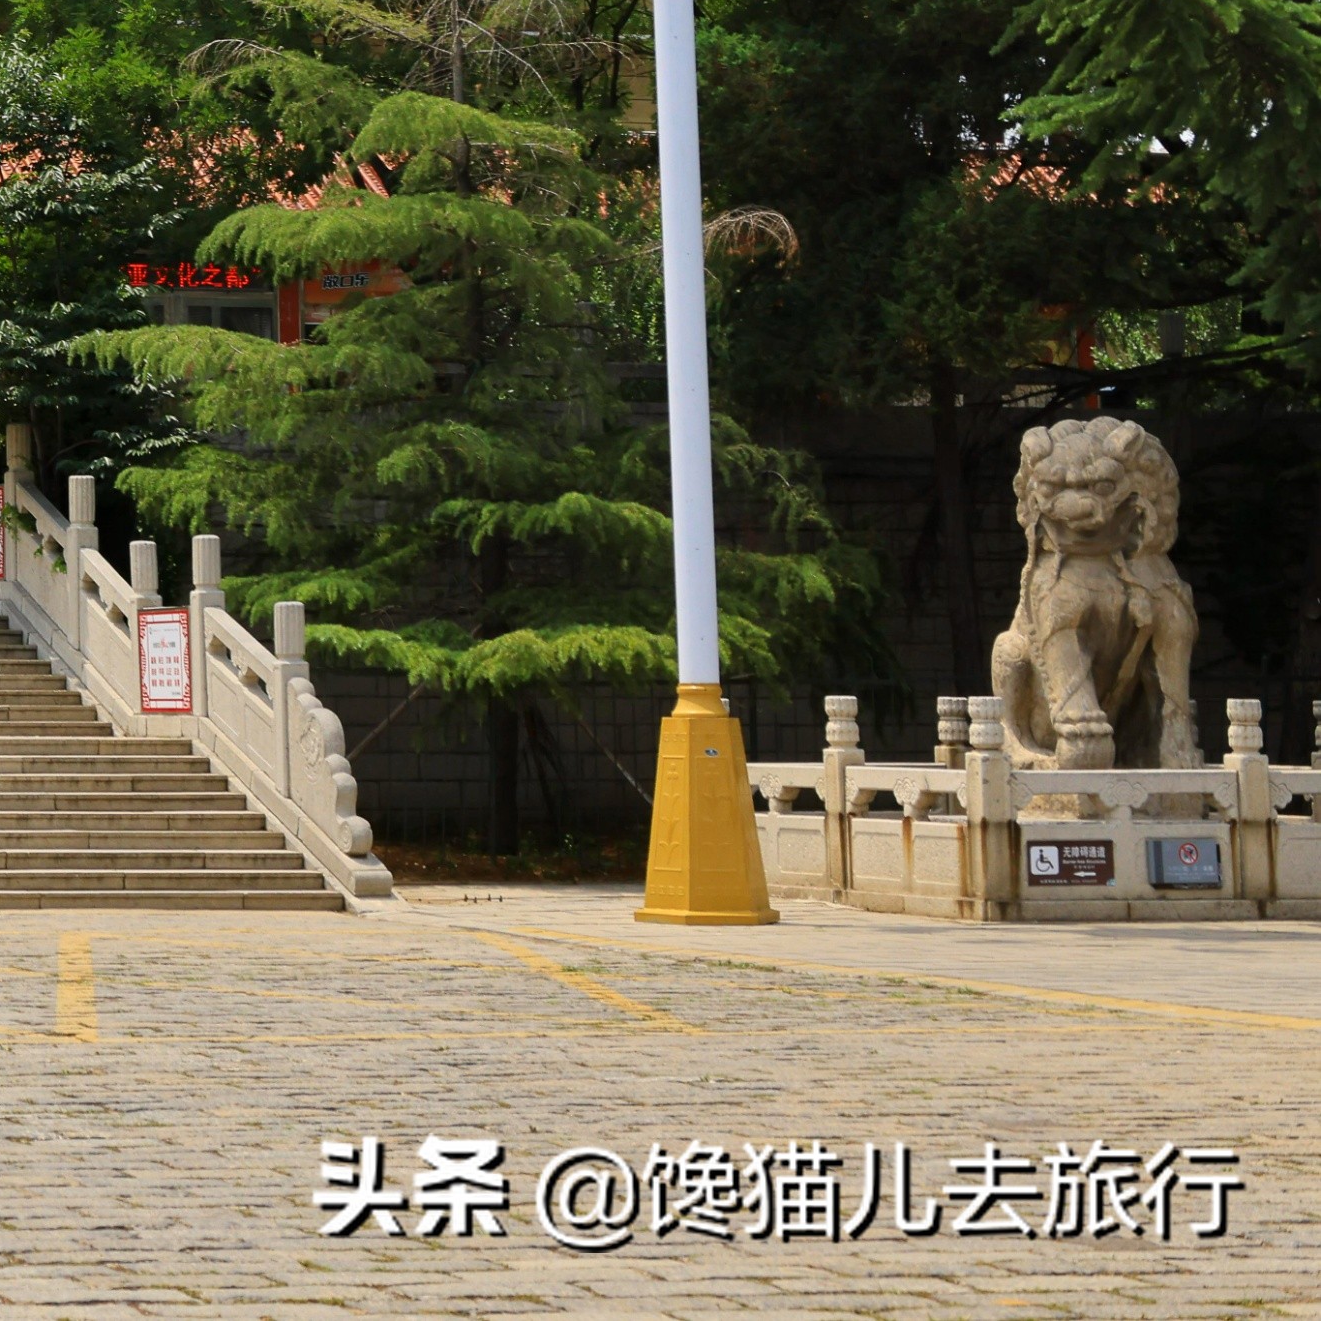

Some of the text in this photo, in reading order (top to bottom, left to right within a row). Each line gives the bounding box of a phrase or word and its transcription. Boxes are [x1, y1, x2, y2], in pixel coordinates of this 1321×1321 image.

[1062, 846, 1106, 858] 无障碍通道
